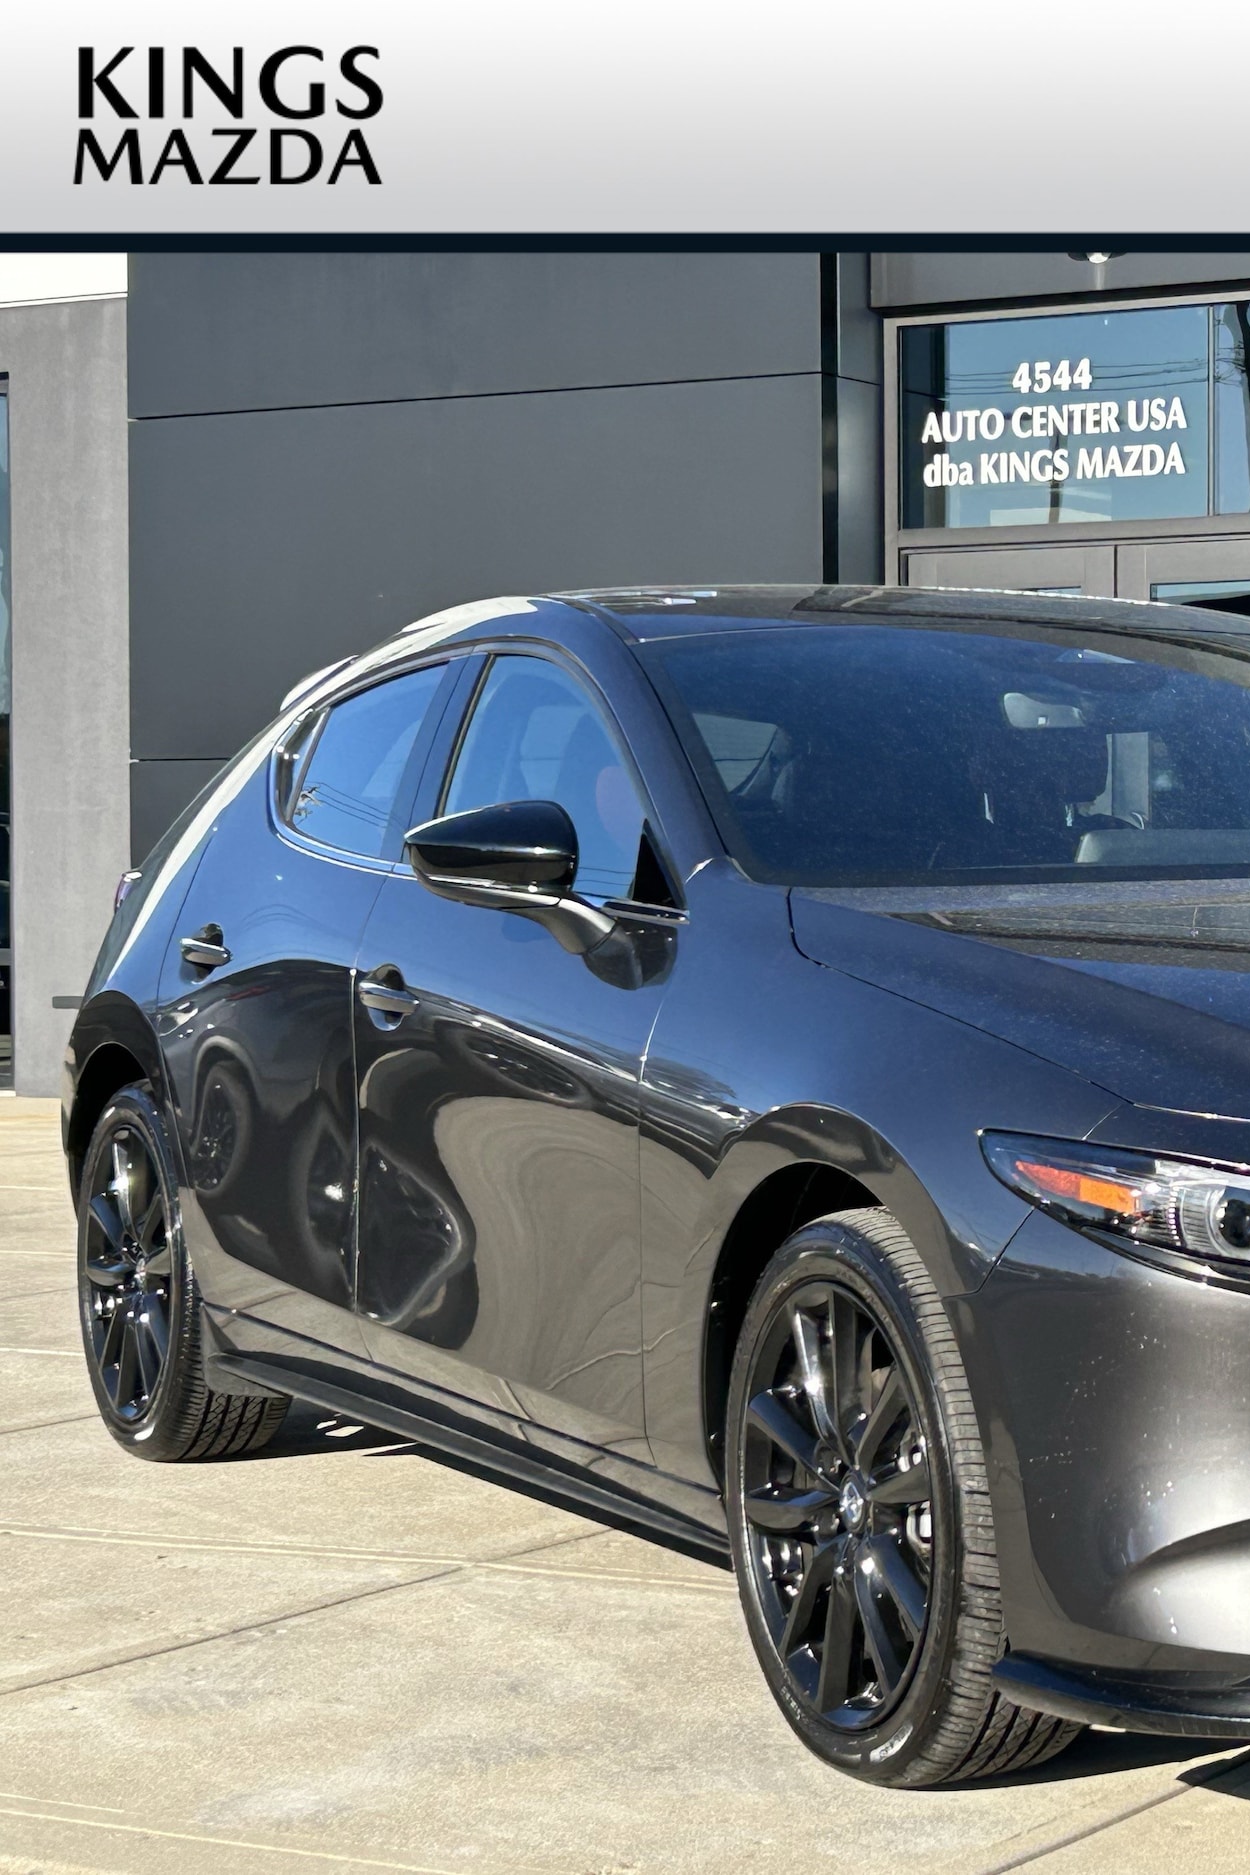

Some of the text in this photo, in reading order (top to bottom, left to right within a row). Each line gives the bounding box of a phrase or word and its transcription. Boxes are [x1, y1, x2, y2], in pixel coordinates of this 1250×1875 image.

[1012, 358, 1093, 393] 4544
[921, 397, 1187, 443] AUTO CENTER USA
[923, 442, 1186, 487] dba KINGS MAZDA
